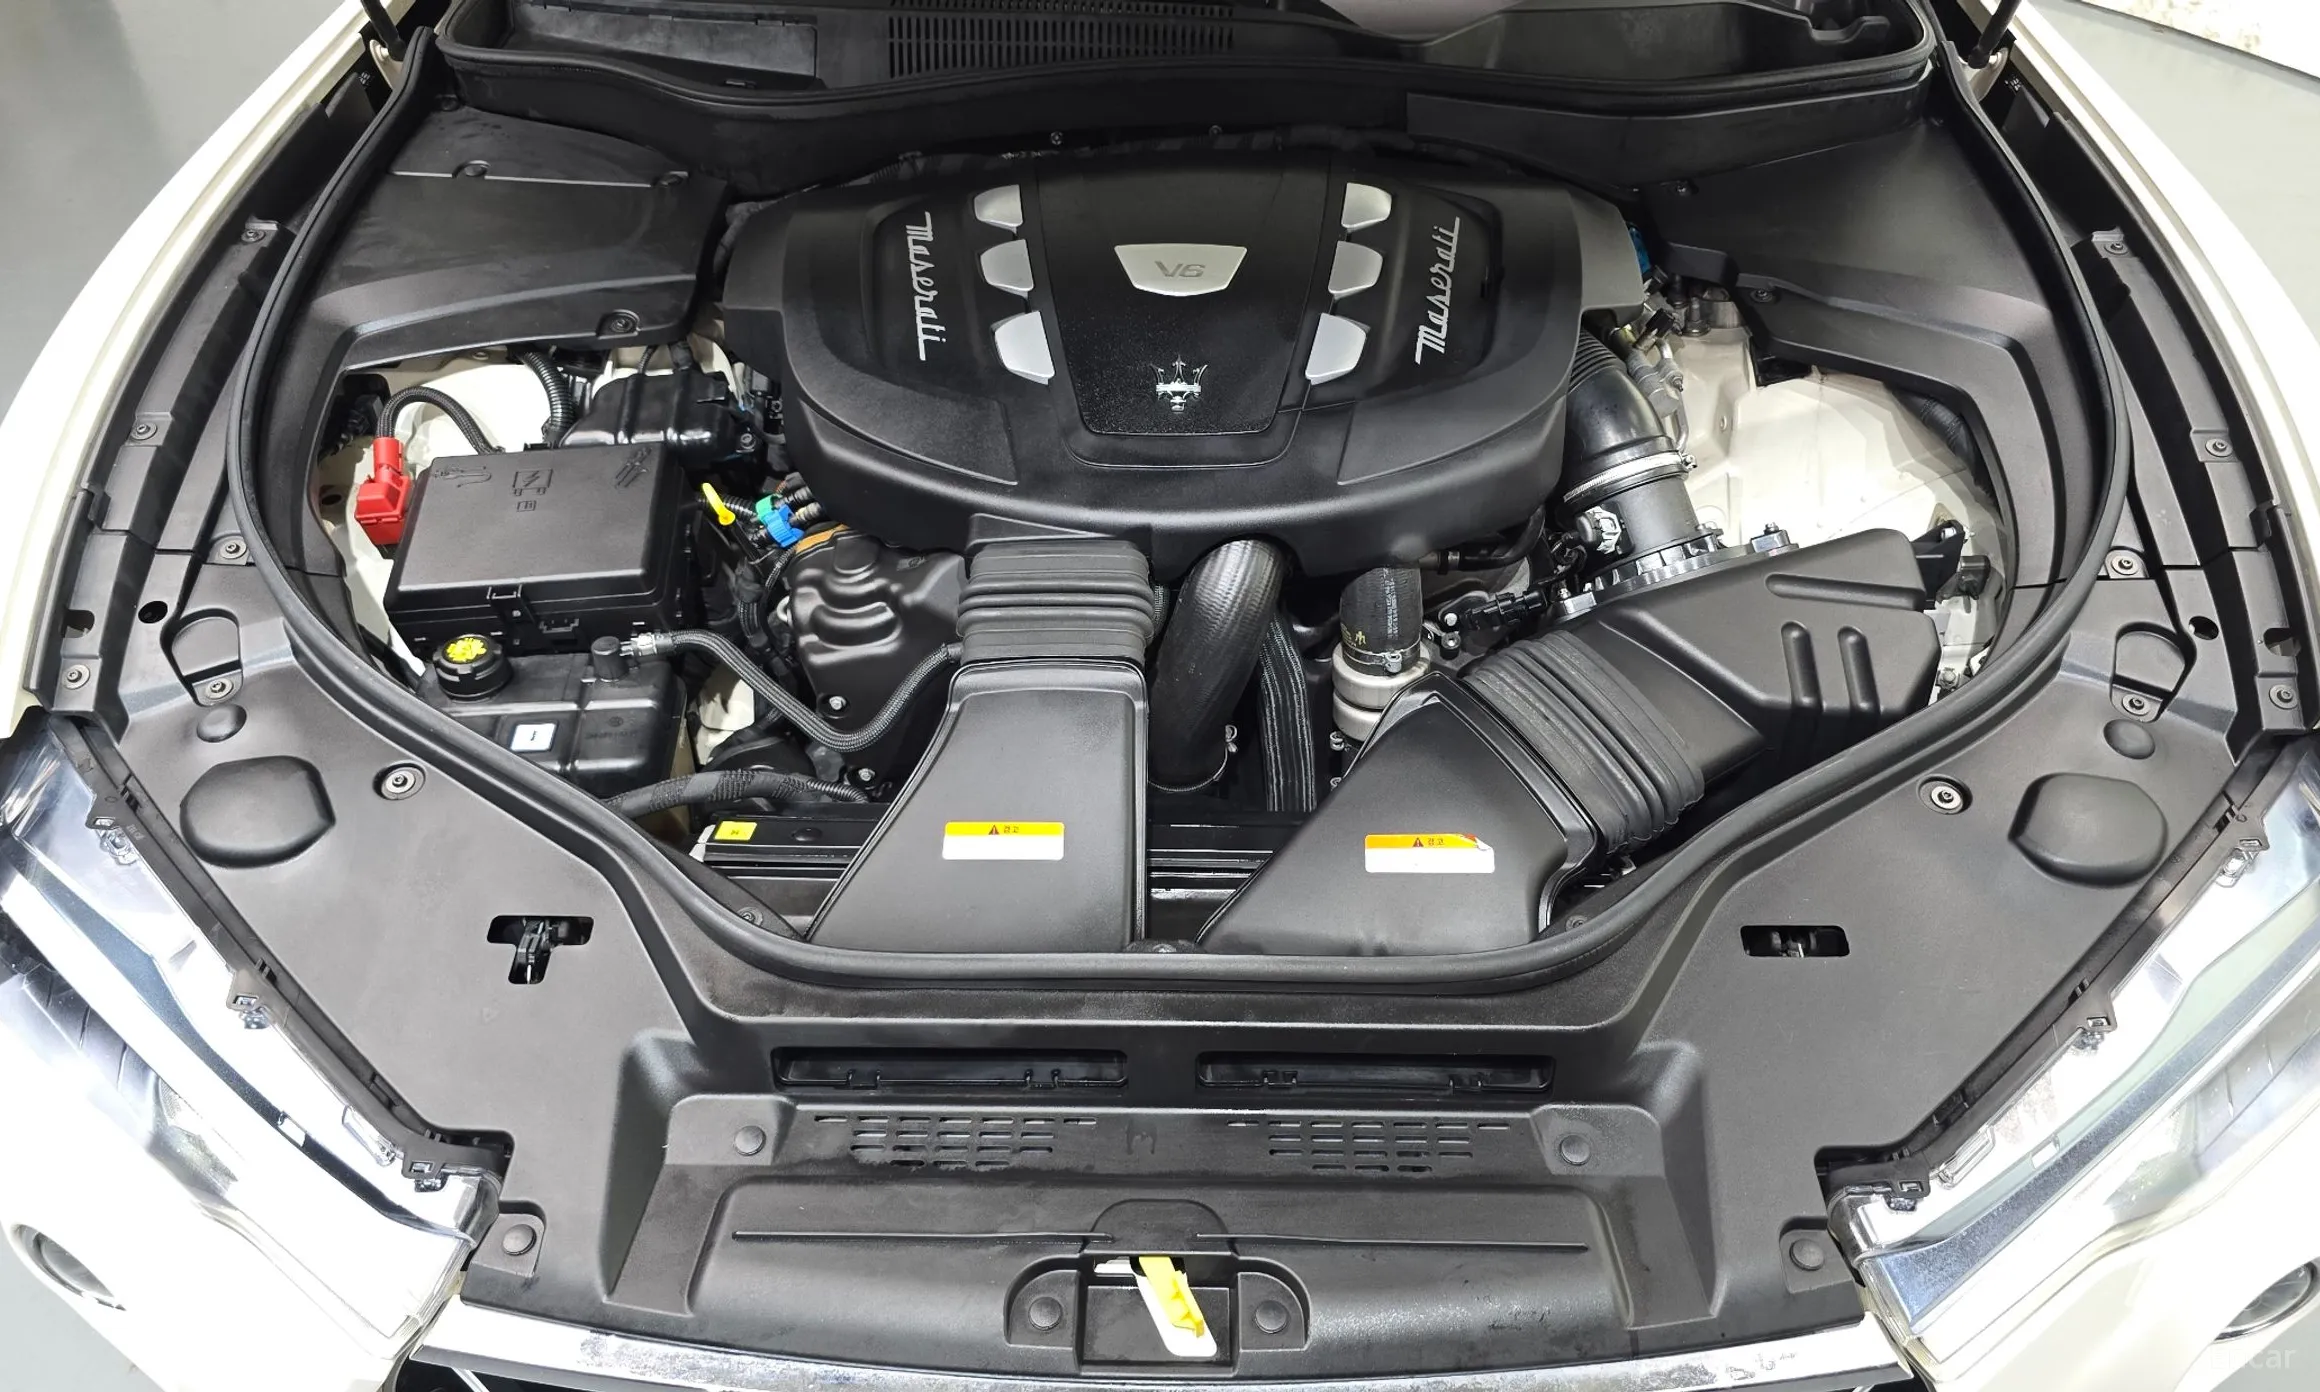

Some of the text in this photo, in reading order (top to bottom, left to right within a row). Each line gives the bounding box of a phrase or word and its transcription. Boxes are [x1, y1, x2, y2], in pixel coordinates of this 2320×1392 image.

[905, 211, 946, 361] Maserati
[1154, 260, 1206, 278] V6
[1415, 216, 1460, 365] Maserati
